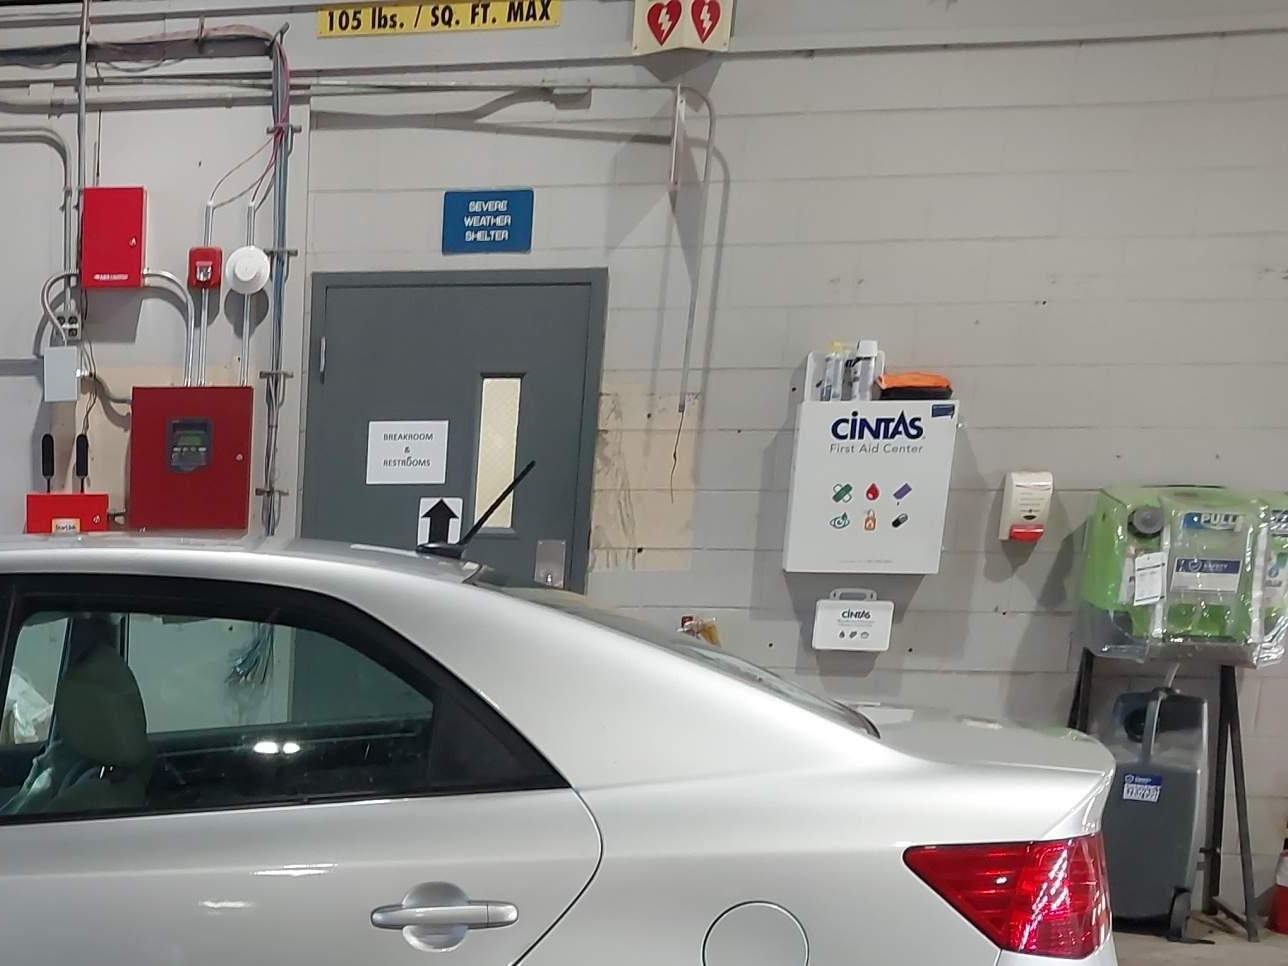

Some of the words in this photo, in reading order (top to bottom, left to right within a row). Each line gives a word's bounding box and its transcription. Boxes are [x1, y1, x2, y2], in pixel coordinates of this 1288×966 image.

[328, 10, 362, 31] 105
[371, 7, 405, 29] lbs.
[430, 4, 461, 27] SQ.
[470, 3, 497, 25] FT.
[506, 0, 552, 23] MAX
[468, 200, 508, 212] SEVERE
[464, 215, 512, 227] WEATHER
[465, 230, 509, 242] SHELTER
[383, 433, 434, 441] BREAKROOM
[830, 443, 855, 453] First
[858, 443, 879, 453] Aid
[883, 443, 923, 453] Center
[383, 458, 431, 467] RESTROOMS
